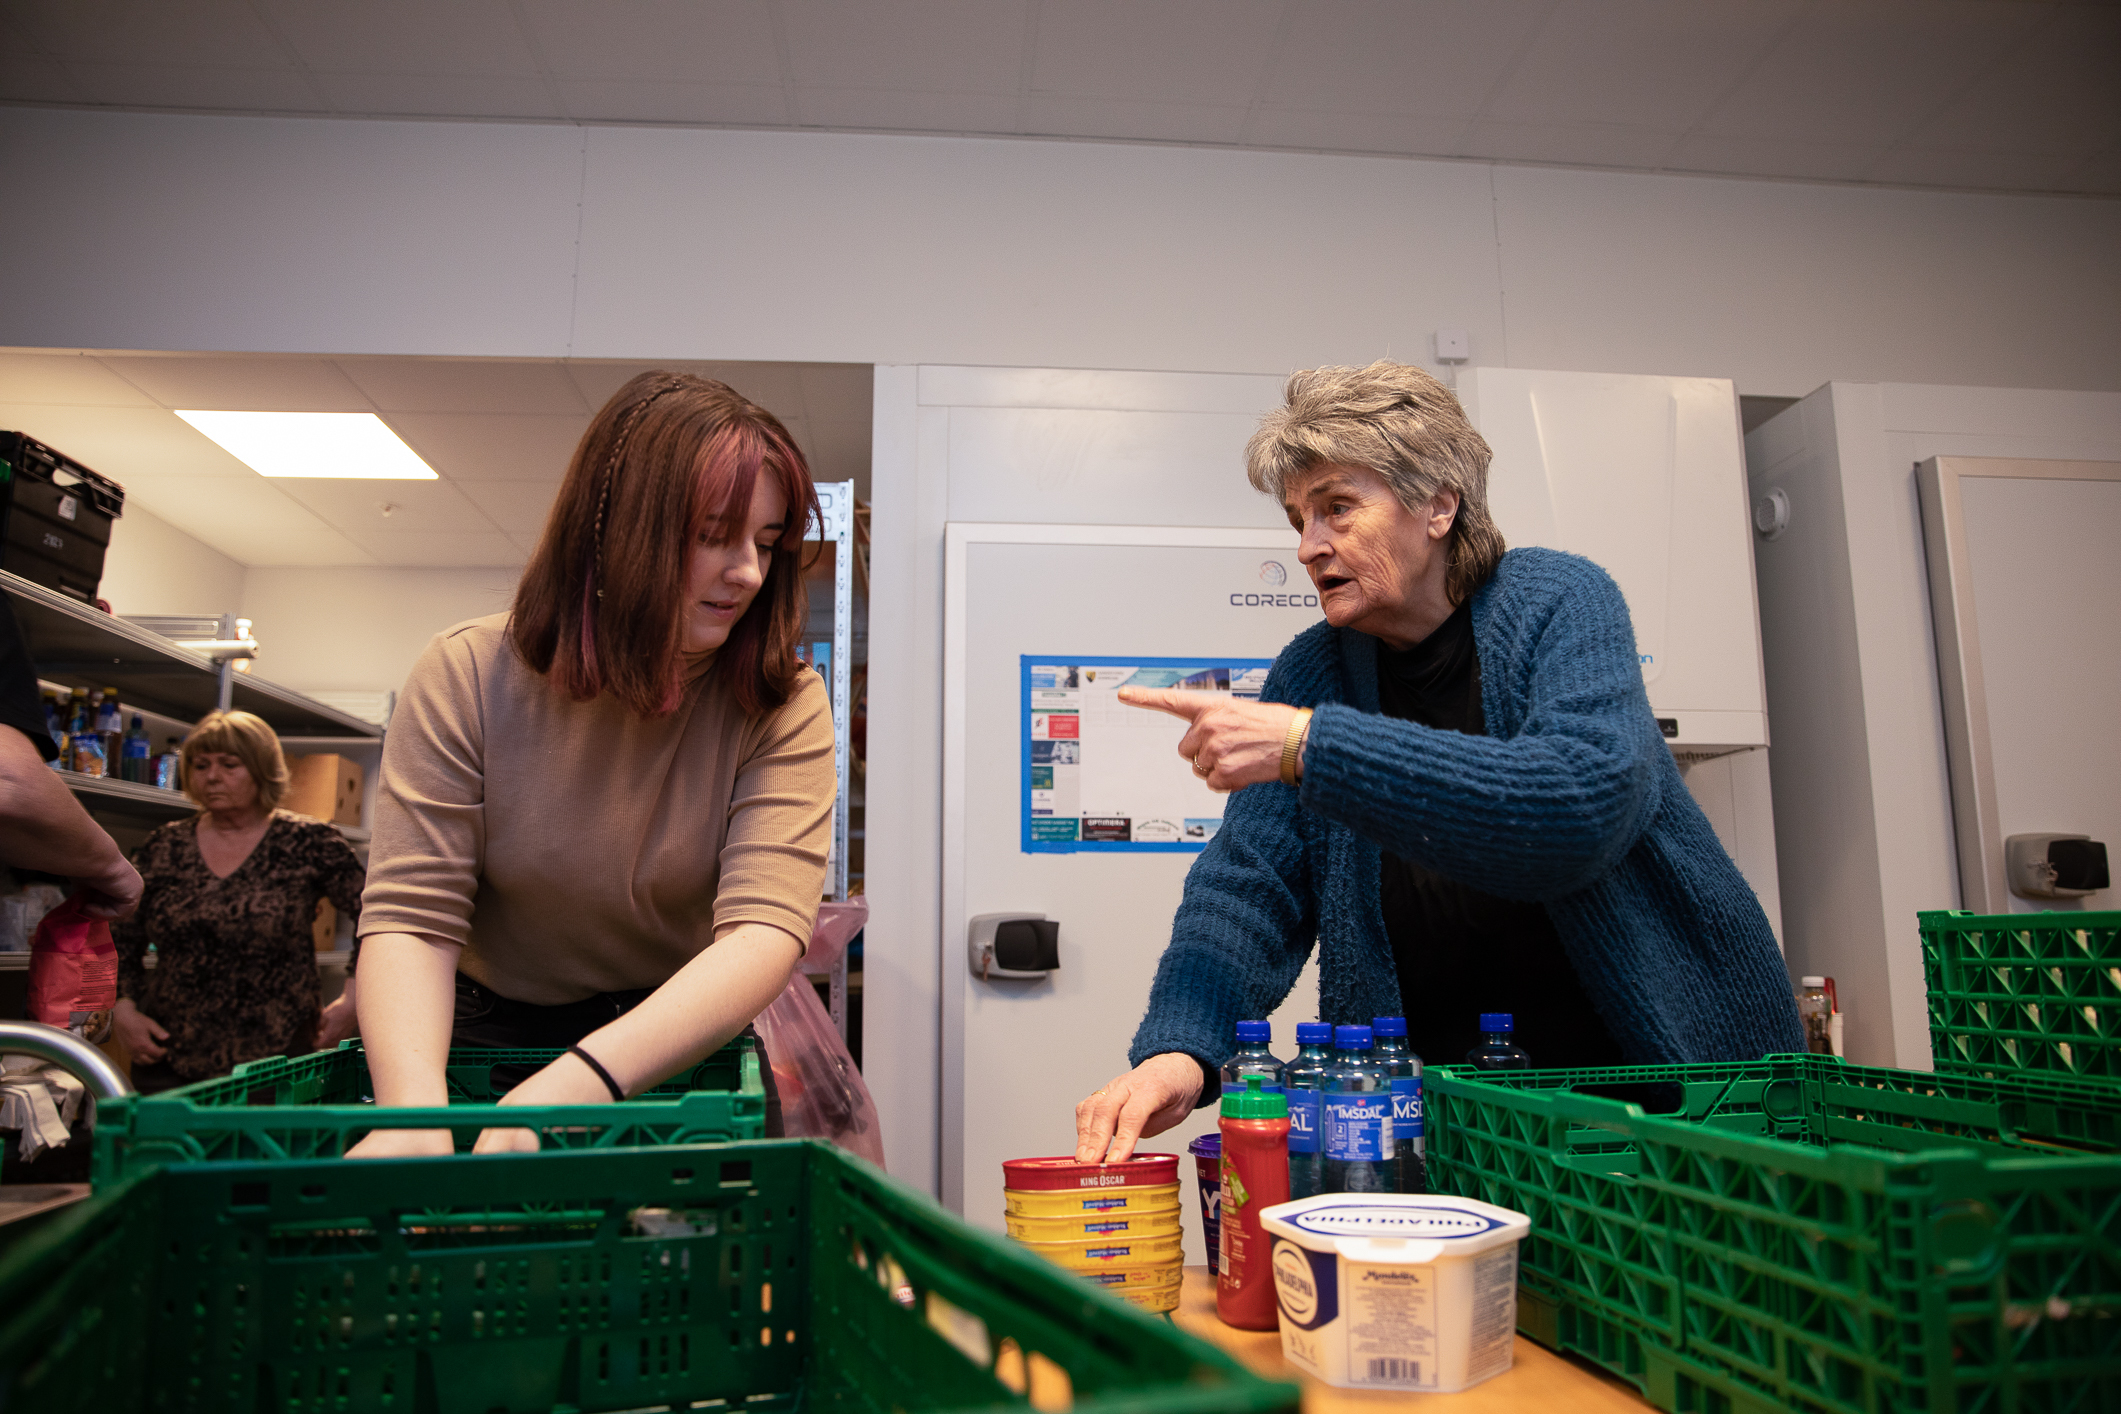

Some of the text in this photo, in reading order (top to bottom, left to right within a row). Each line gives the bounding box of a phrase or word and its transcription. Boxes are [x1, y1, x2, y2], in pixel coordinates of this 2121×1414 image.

[1230, 593, 1318, 607] CORECO
[1338, 1106, 1382, 1119] IMSDAL
[1080, 1175, 1125, 1187] KING OSCAR
[1304, 1215, 1482, 1228] PHILADELPHIA
